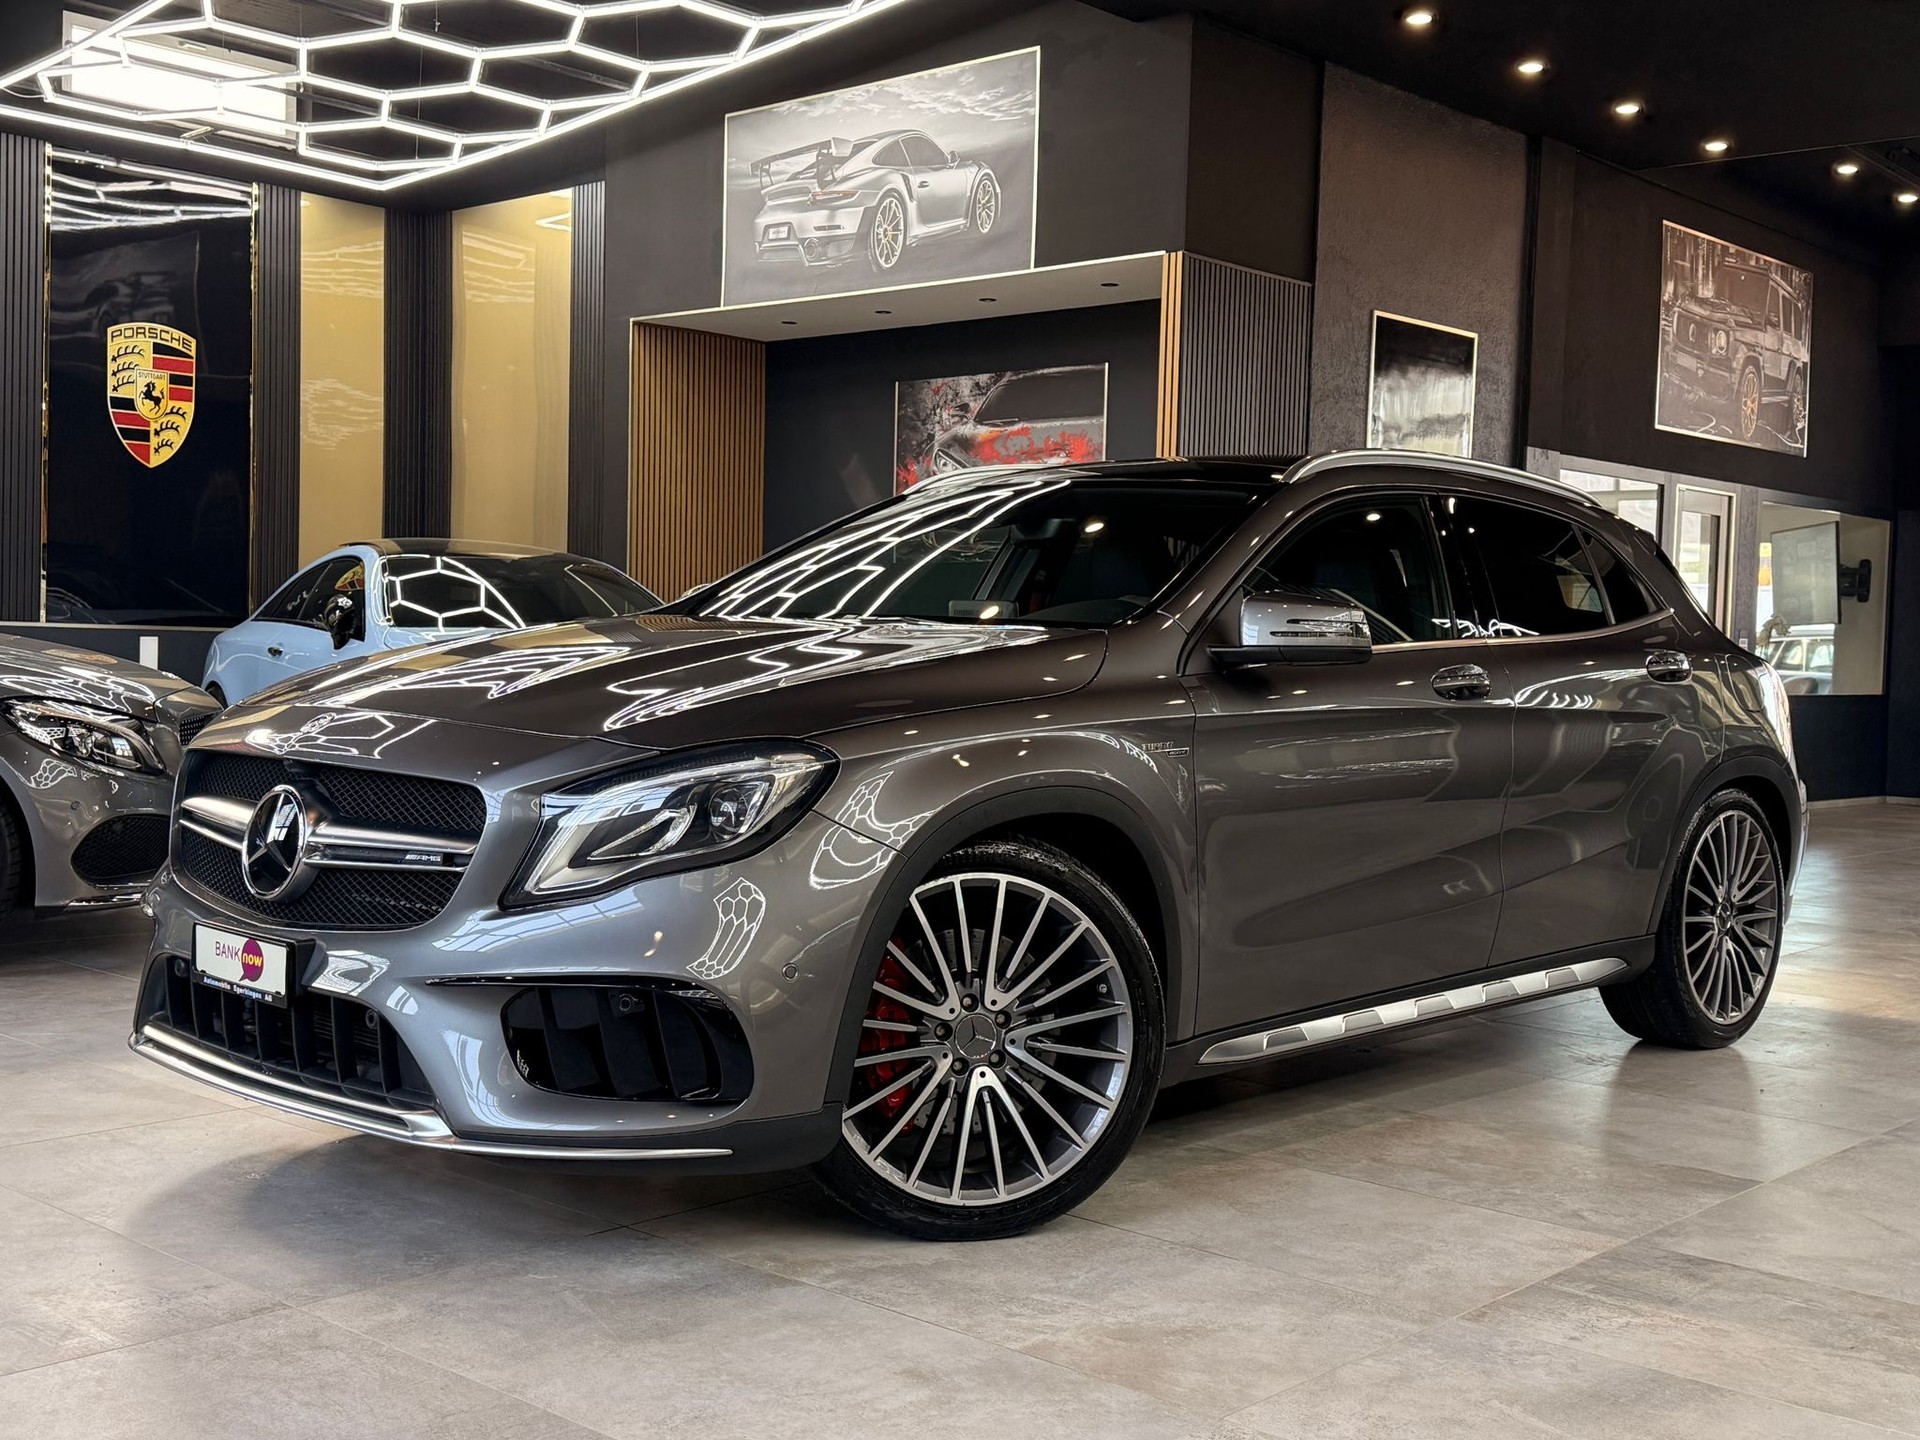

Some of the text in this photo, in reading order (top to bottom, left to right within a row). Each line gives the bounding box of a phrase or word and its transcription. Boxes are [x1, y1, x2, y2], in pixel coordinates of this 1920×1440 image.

[111, 326, 192, 352] PORSCHE
[138, 371, 166, 381] STUTTGART
[215, 941, 262, 967] BANK now
